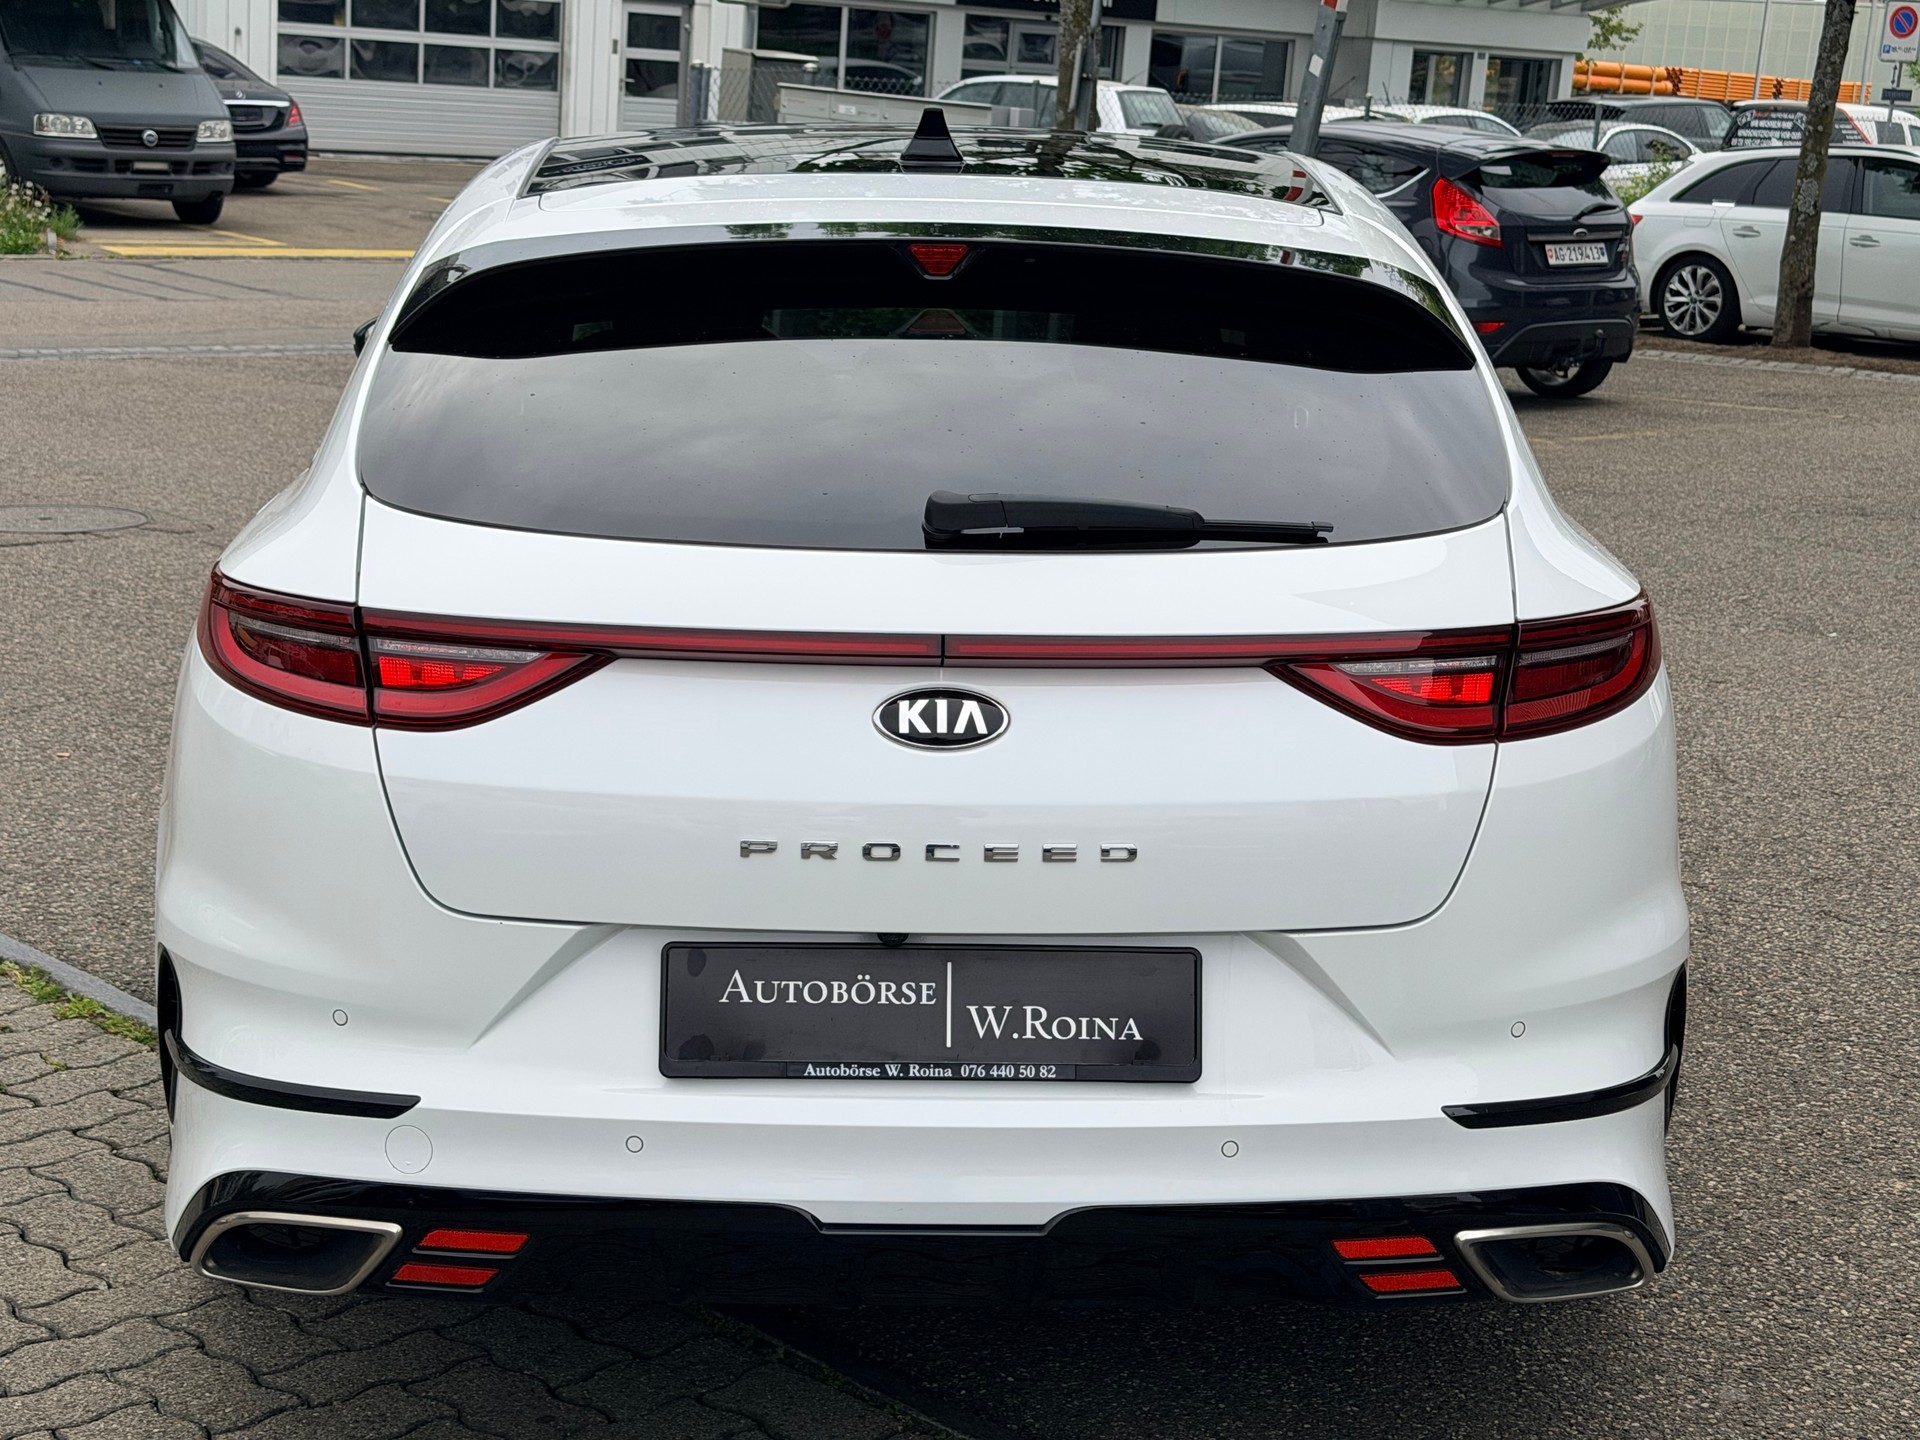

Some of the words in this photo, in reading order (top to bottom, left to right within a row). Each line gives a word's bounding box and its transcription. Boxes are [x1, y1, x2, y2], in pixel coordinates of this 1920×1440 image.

[897, 698, 989, 735] KIA
[739, 838, 1138, 863] PROCEED
[803, 1063, 881, 1078] Autobörse
[884, 1064, 904, 1078] W.
[908, 1064, 953, 1078] Roina
[960, 1065, 986, 1078] 076
[989, 1065, 1015, 1078] 440
[1018, 1065, 1036, 1078] 50
[1039, 1065, 1057, 1078] 82
